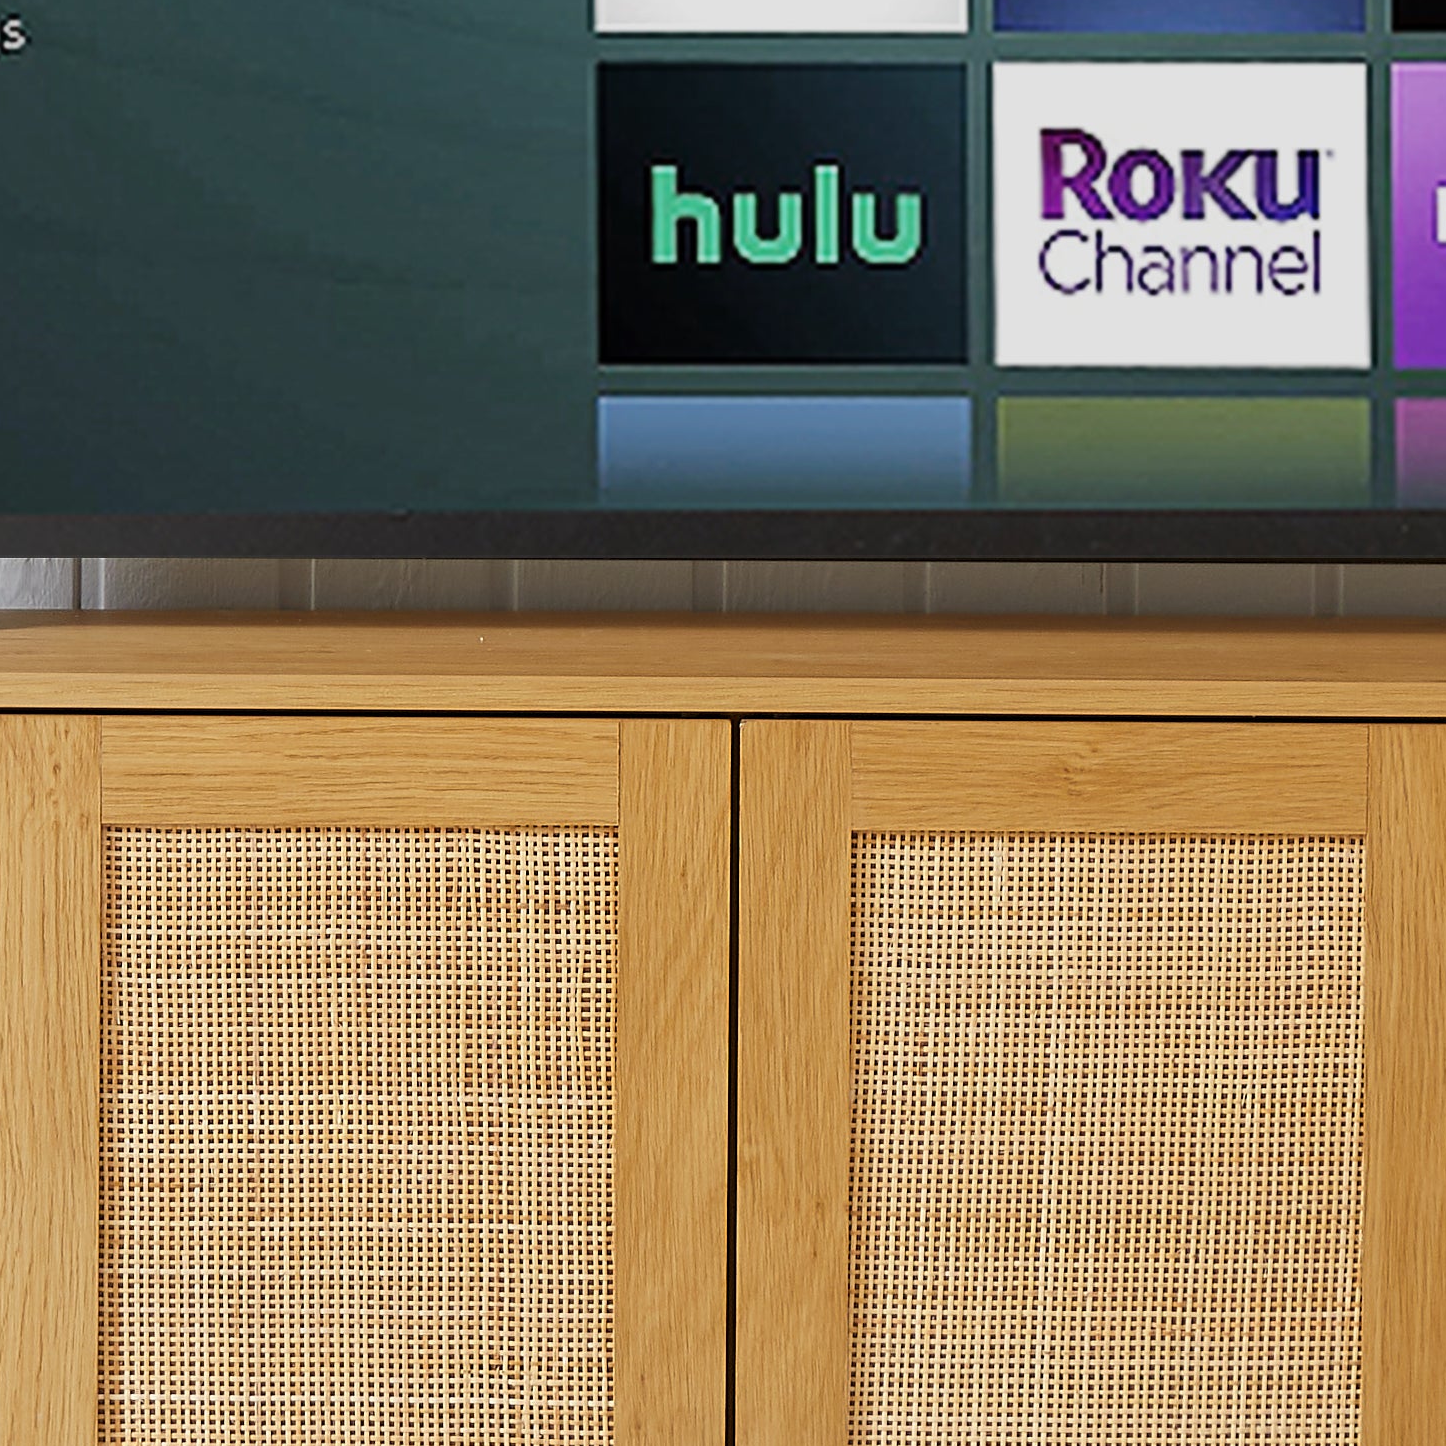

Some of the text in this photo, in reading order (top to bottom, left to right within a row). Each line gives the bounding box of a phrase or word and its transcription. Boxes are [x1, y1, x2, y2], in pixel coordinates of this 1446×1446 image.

[651, 165, 921, 264] hulu
[1039, 127, 1321, 221] Roku
[1038, 229, 1321, 297] Channel
